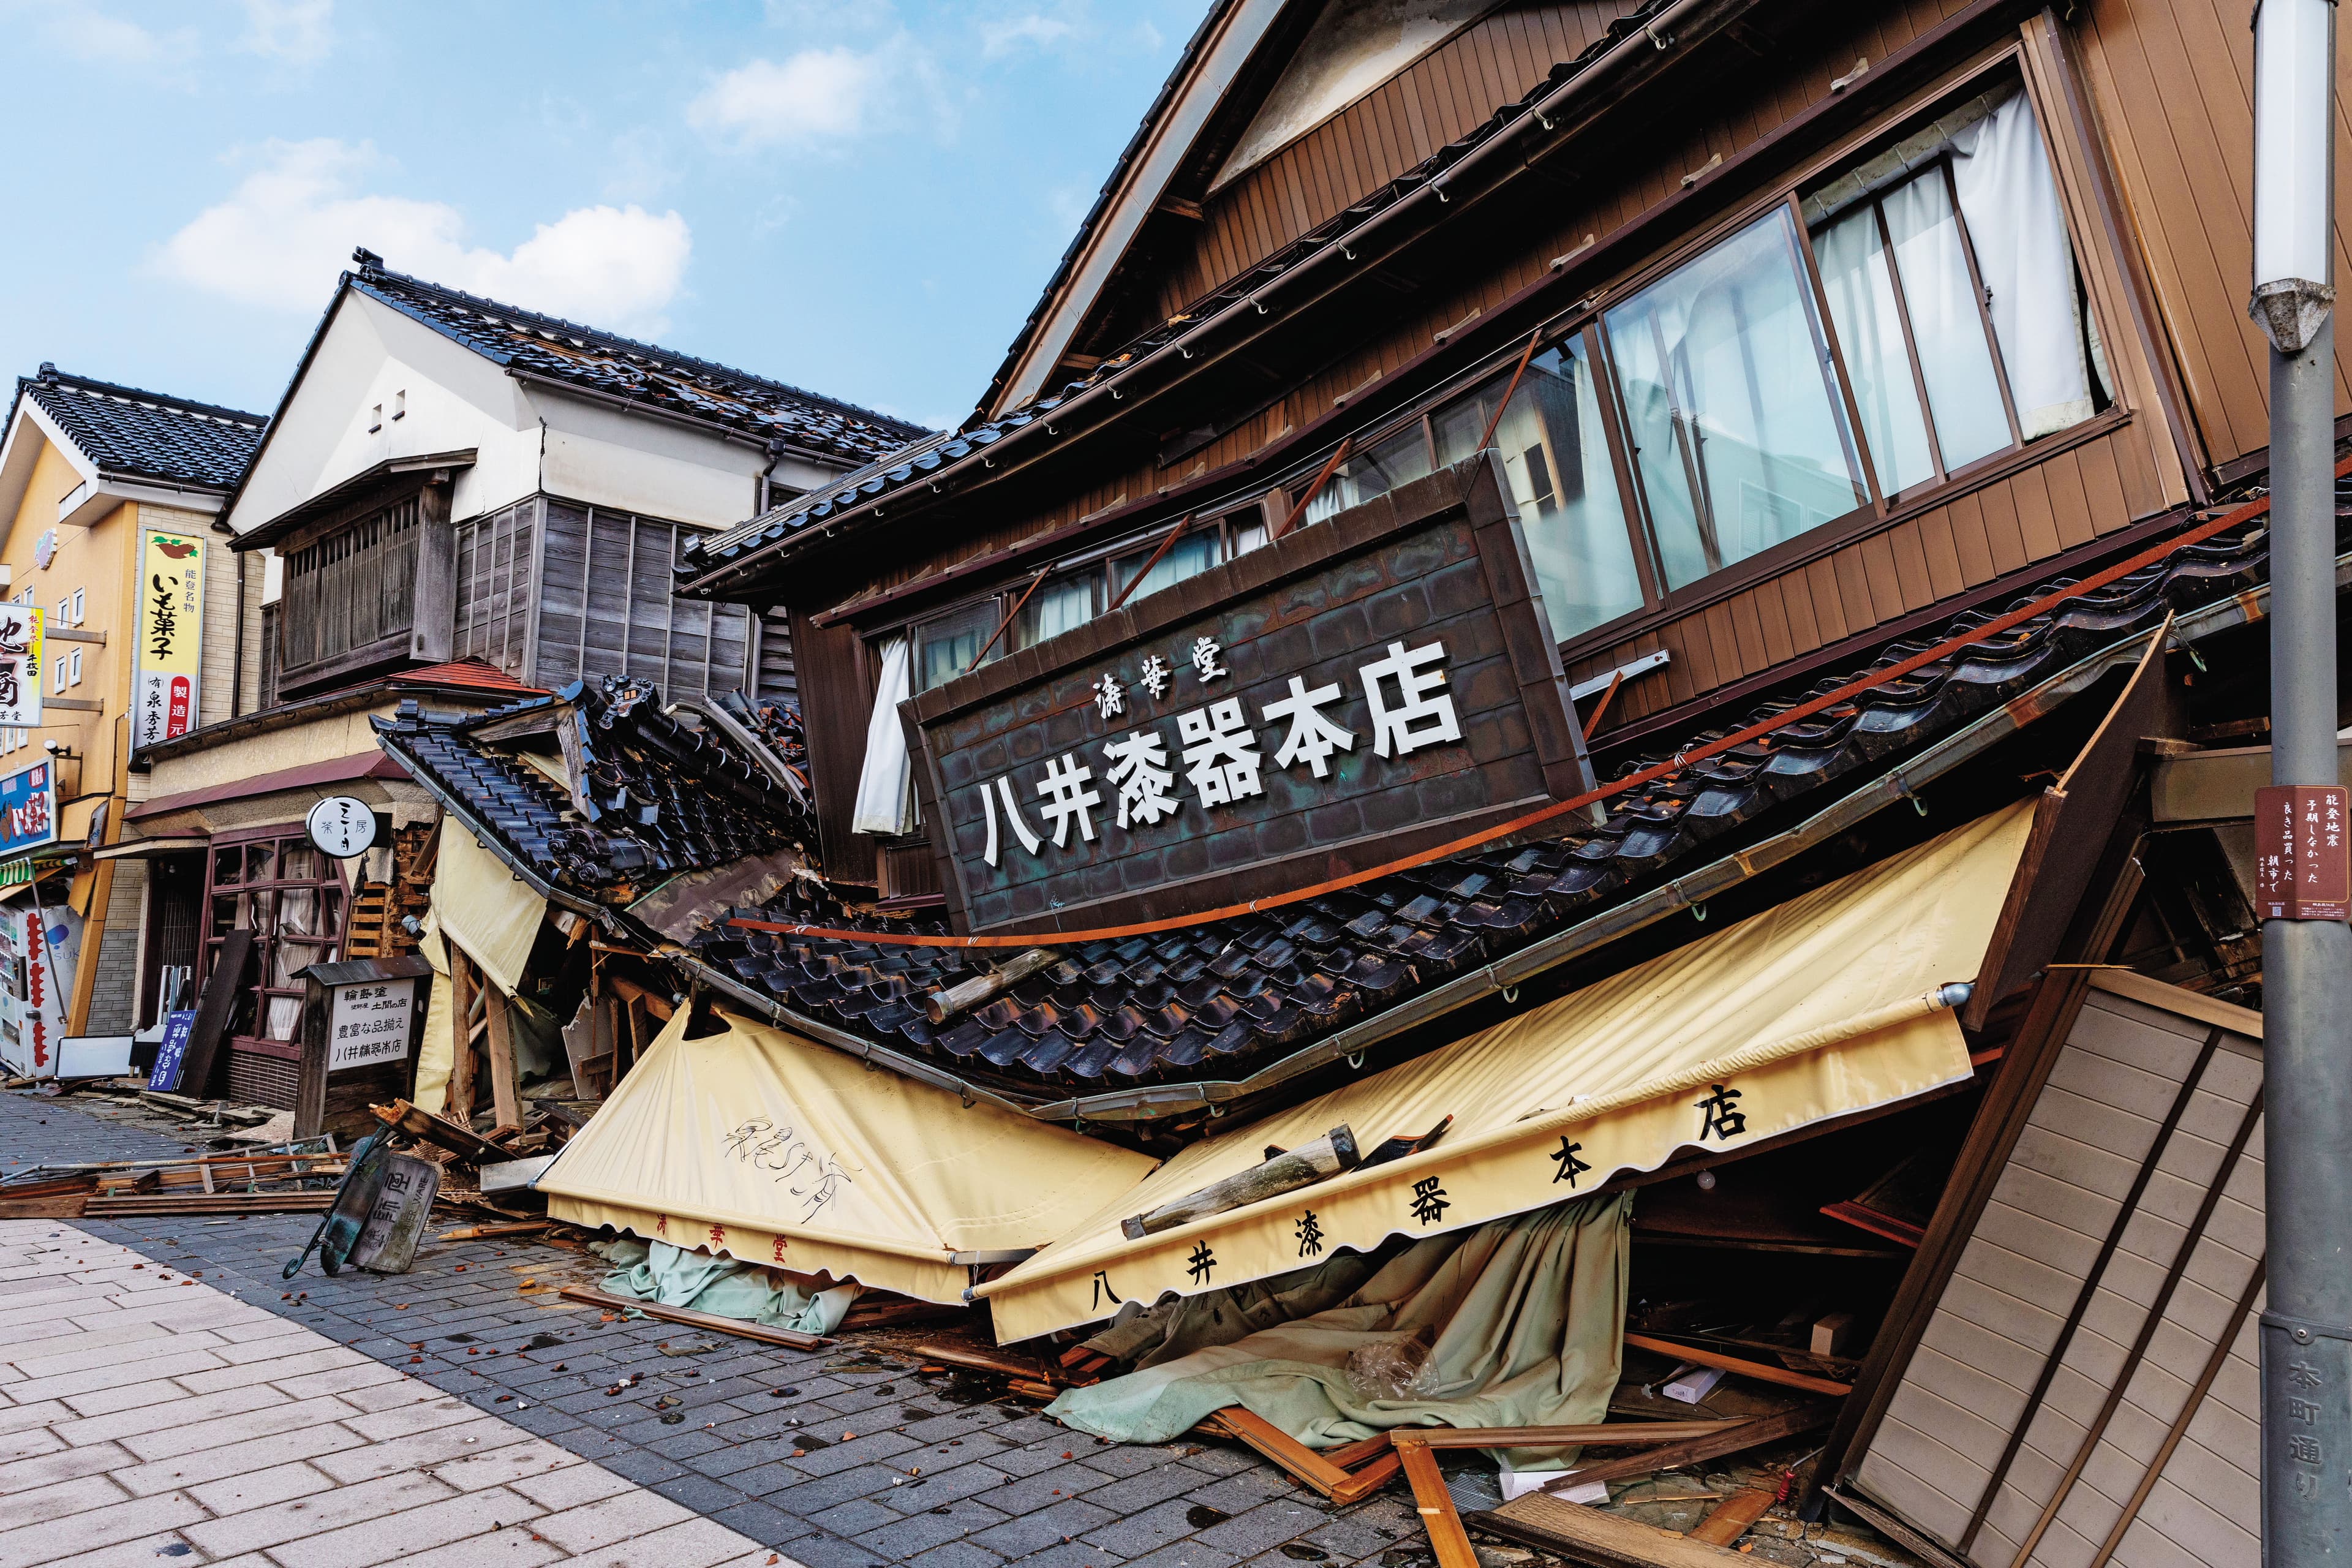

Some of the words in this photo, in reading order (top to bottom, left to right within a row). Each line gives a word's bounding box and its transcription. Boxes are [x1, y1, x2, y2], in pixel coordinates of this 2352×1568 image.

[183, 568, 197, 613] 能登名物
[150, 574, 178, 660] いも菓子
[26, 654, 39, 677] 千枚田
[170, 685, 187, 736] 製造元
[979, 641, 1461, 867] 八井漆器本店
[2282, 802, 2293, 881] 良き品買った
[2305, 800, 2318, 883] 予期しなかった
[2325, 794, 2340, 846] 能登地震
[2267, 855, 2279, 892] 朝市で
[344, 986, 388, 1002] 輪島塗
[336, 1038, 402, 1062] 八井漆器本店
[337, 1017, 404, 1039] 豊富な品揃え
[412, 1177, 429, 1205] WARE
[1091, 1084, 1747, 1311] 八井漆器本店
[2288, 1361, 2323, 1500] 本町通り
